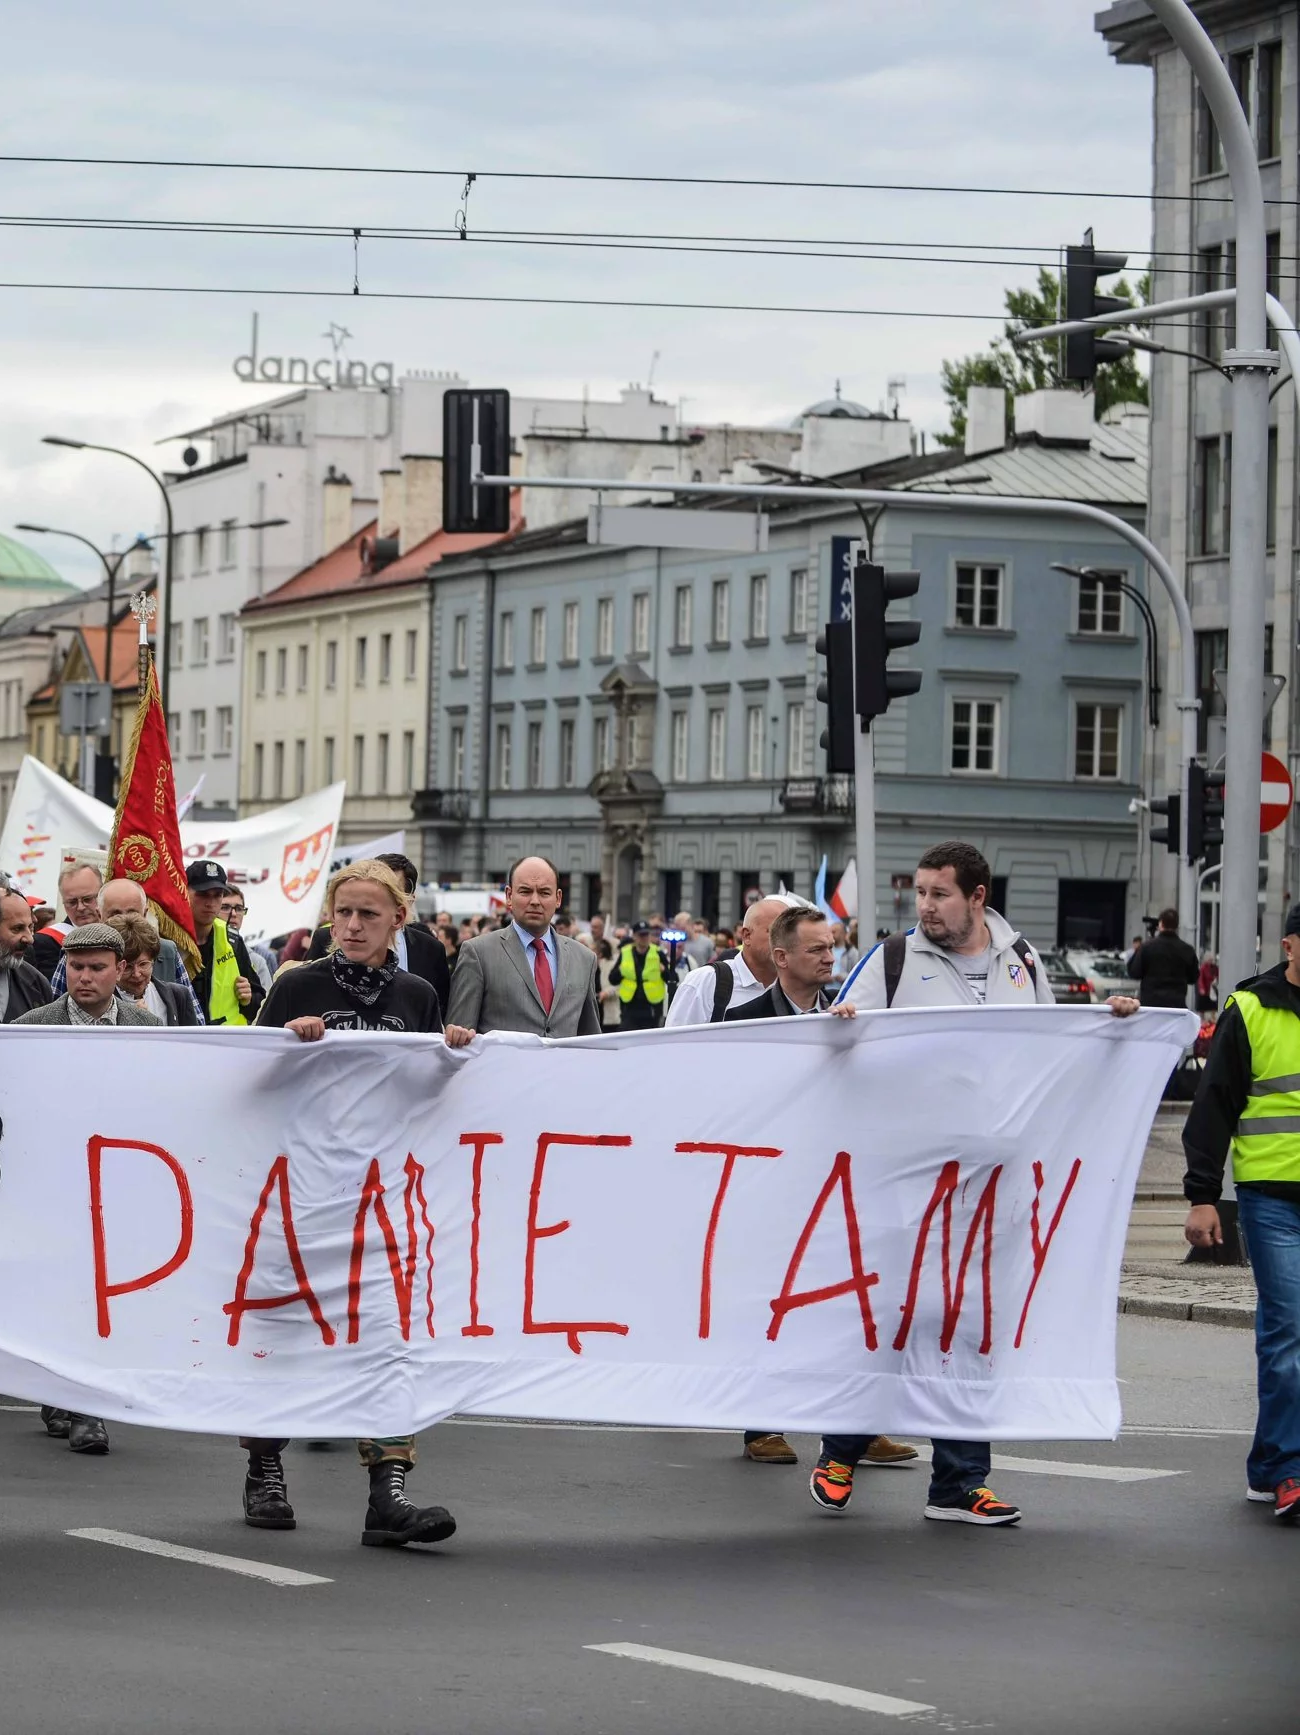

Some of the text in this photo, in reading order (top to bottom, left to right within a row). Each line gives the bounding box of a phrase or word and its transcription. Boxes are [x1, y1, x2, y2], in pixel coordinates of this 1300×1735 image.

[233, 312, 394, 387] dancing
[128, 846, 147, 869] 1830
[216, 951, 236, 965] POLIC
[85, 1132, 1082, 1356] PAMIĘTAMY
